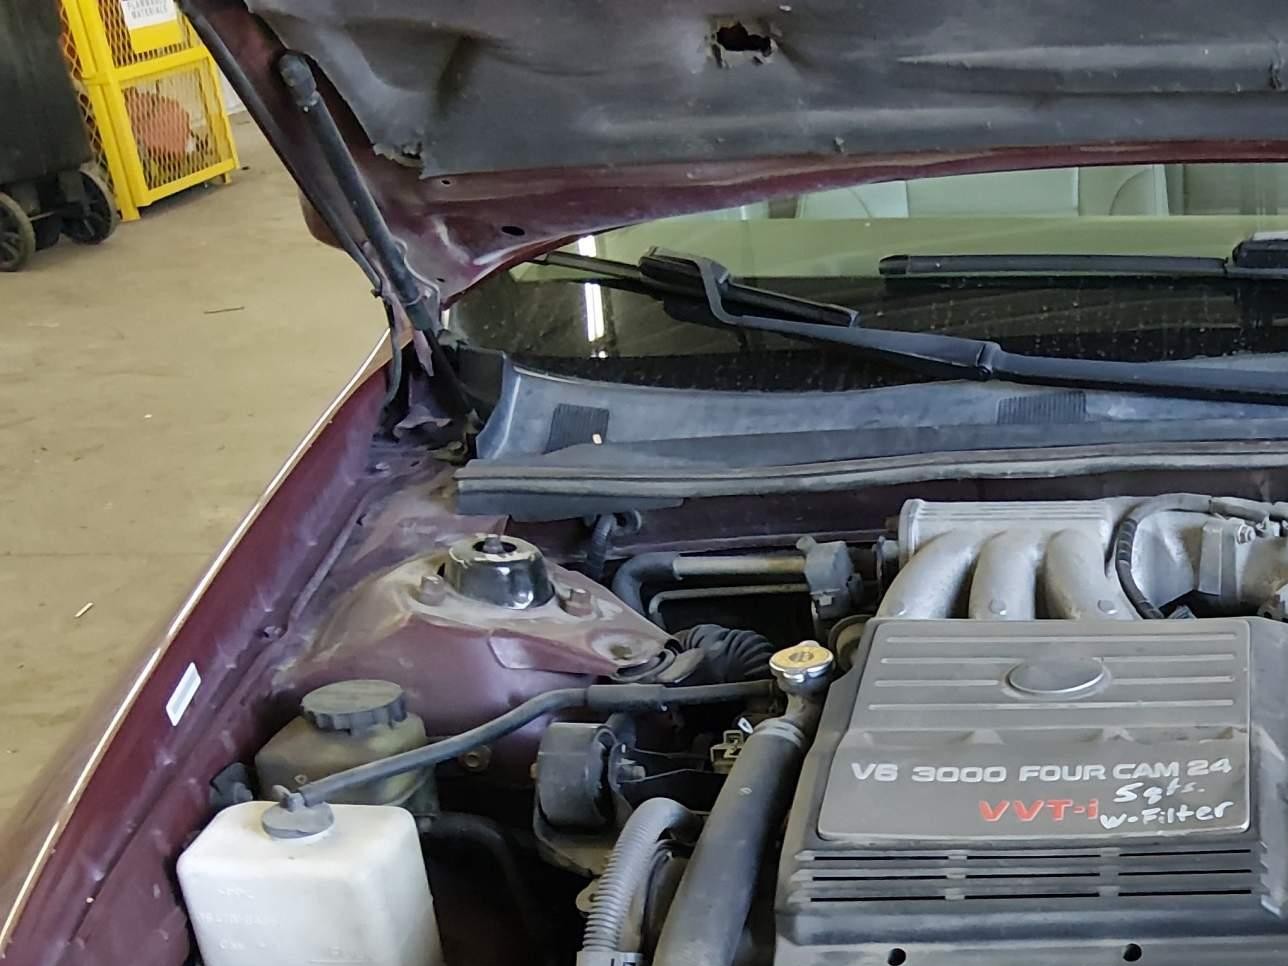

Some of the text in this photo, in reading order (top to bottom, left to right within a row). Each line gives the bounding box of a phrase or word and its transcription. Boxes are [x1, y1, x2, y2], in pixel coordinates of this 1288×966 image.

[851, 757, 1233, 783] V6 3000 FOUR CAM 24
[978, 798, 1099, 823] VVT-i
